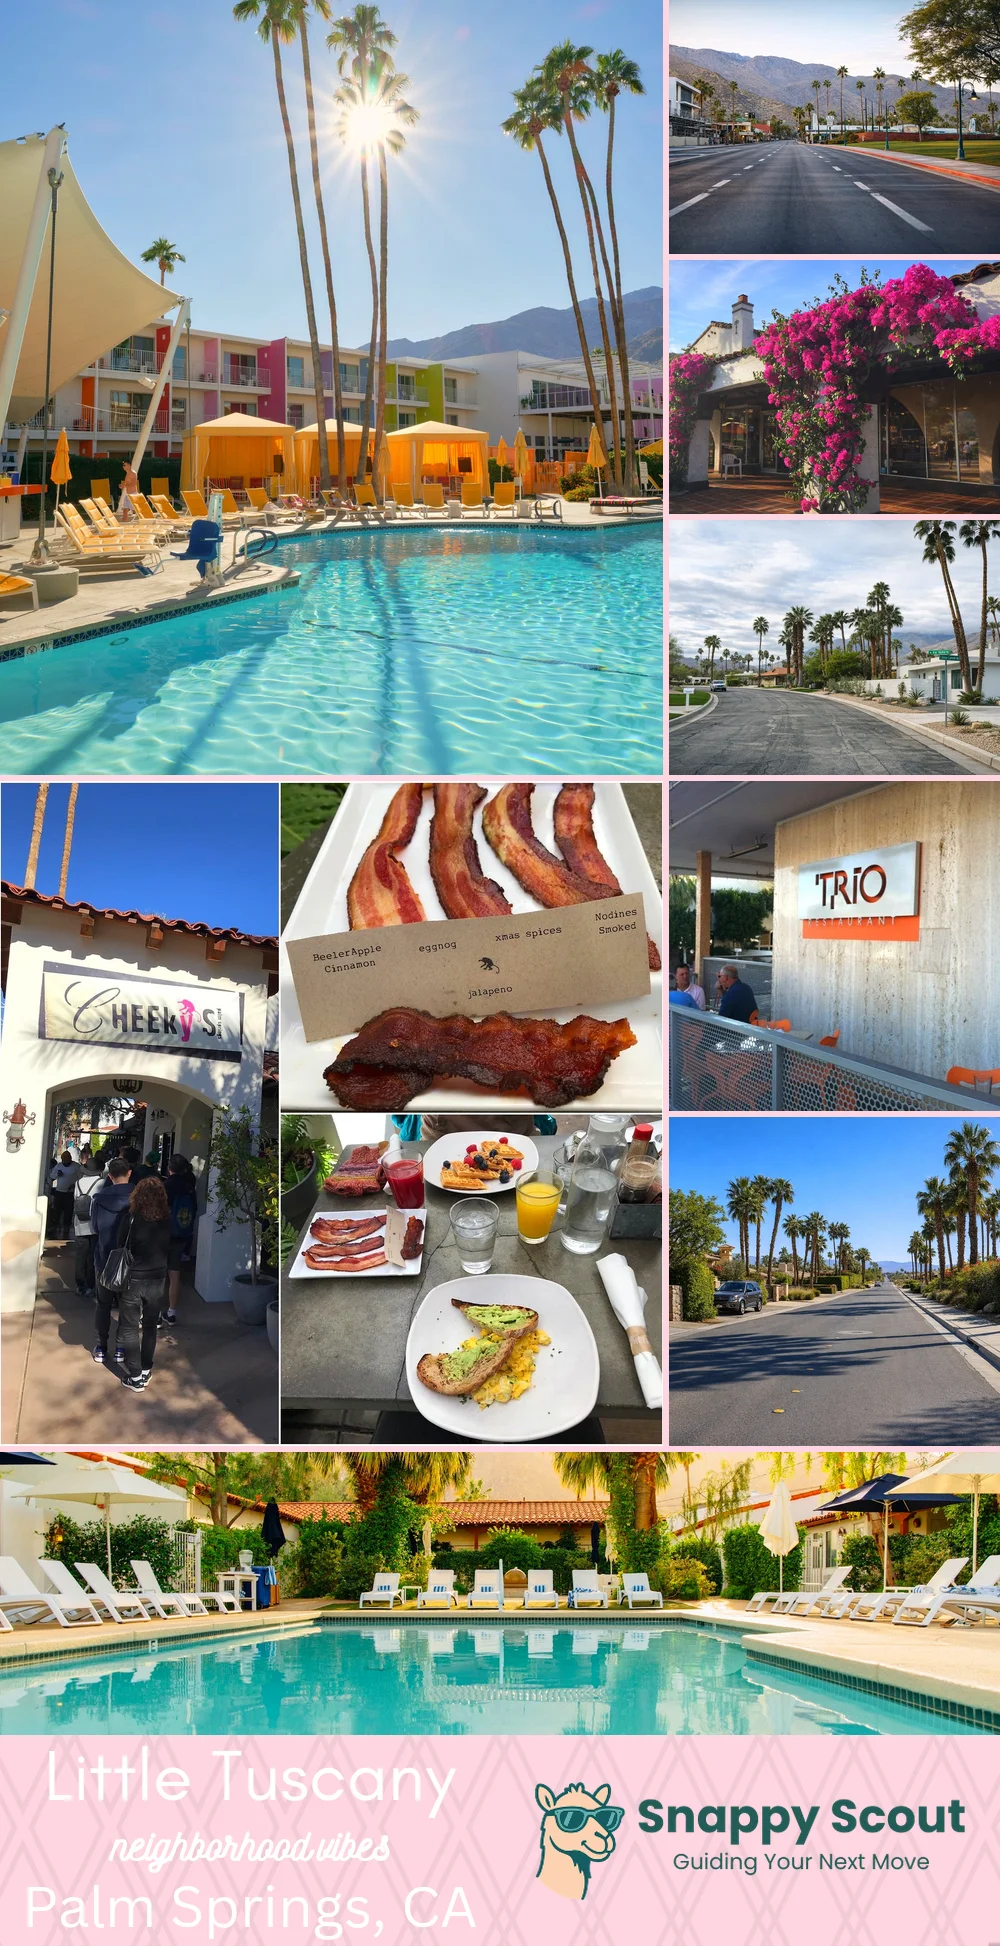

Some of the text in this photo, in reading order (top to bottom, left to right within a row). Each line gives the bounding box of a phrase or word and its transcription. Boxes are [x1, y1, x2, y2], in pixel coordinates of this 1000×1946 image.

[595, 908, 637, 921] Nodines
[807, 915, 896, 927] RESTAURANT
[495, 926, 562, 942] xmas spices
[599, 922, 637, 935] Smoked
[313, 944, 382, 962] BeelerApple
[418, 941, 457, 953] eggnog
[324, 959, 376, 973] Cinnamon
[467, 985, 513, 999] jalapeno
